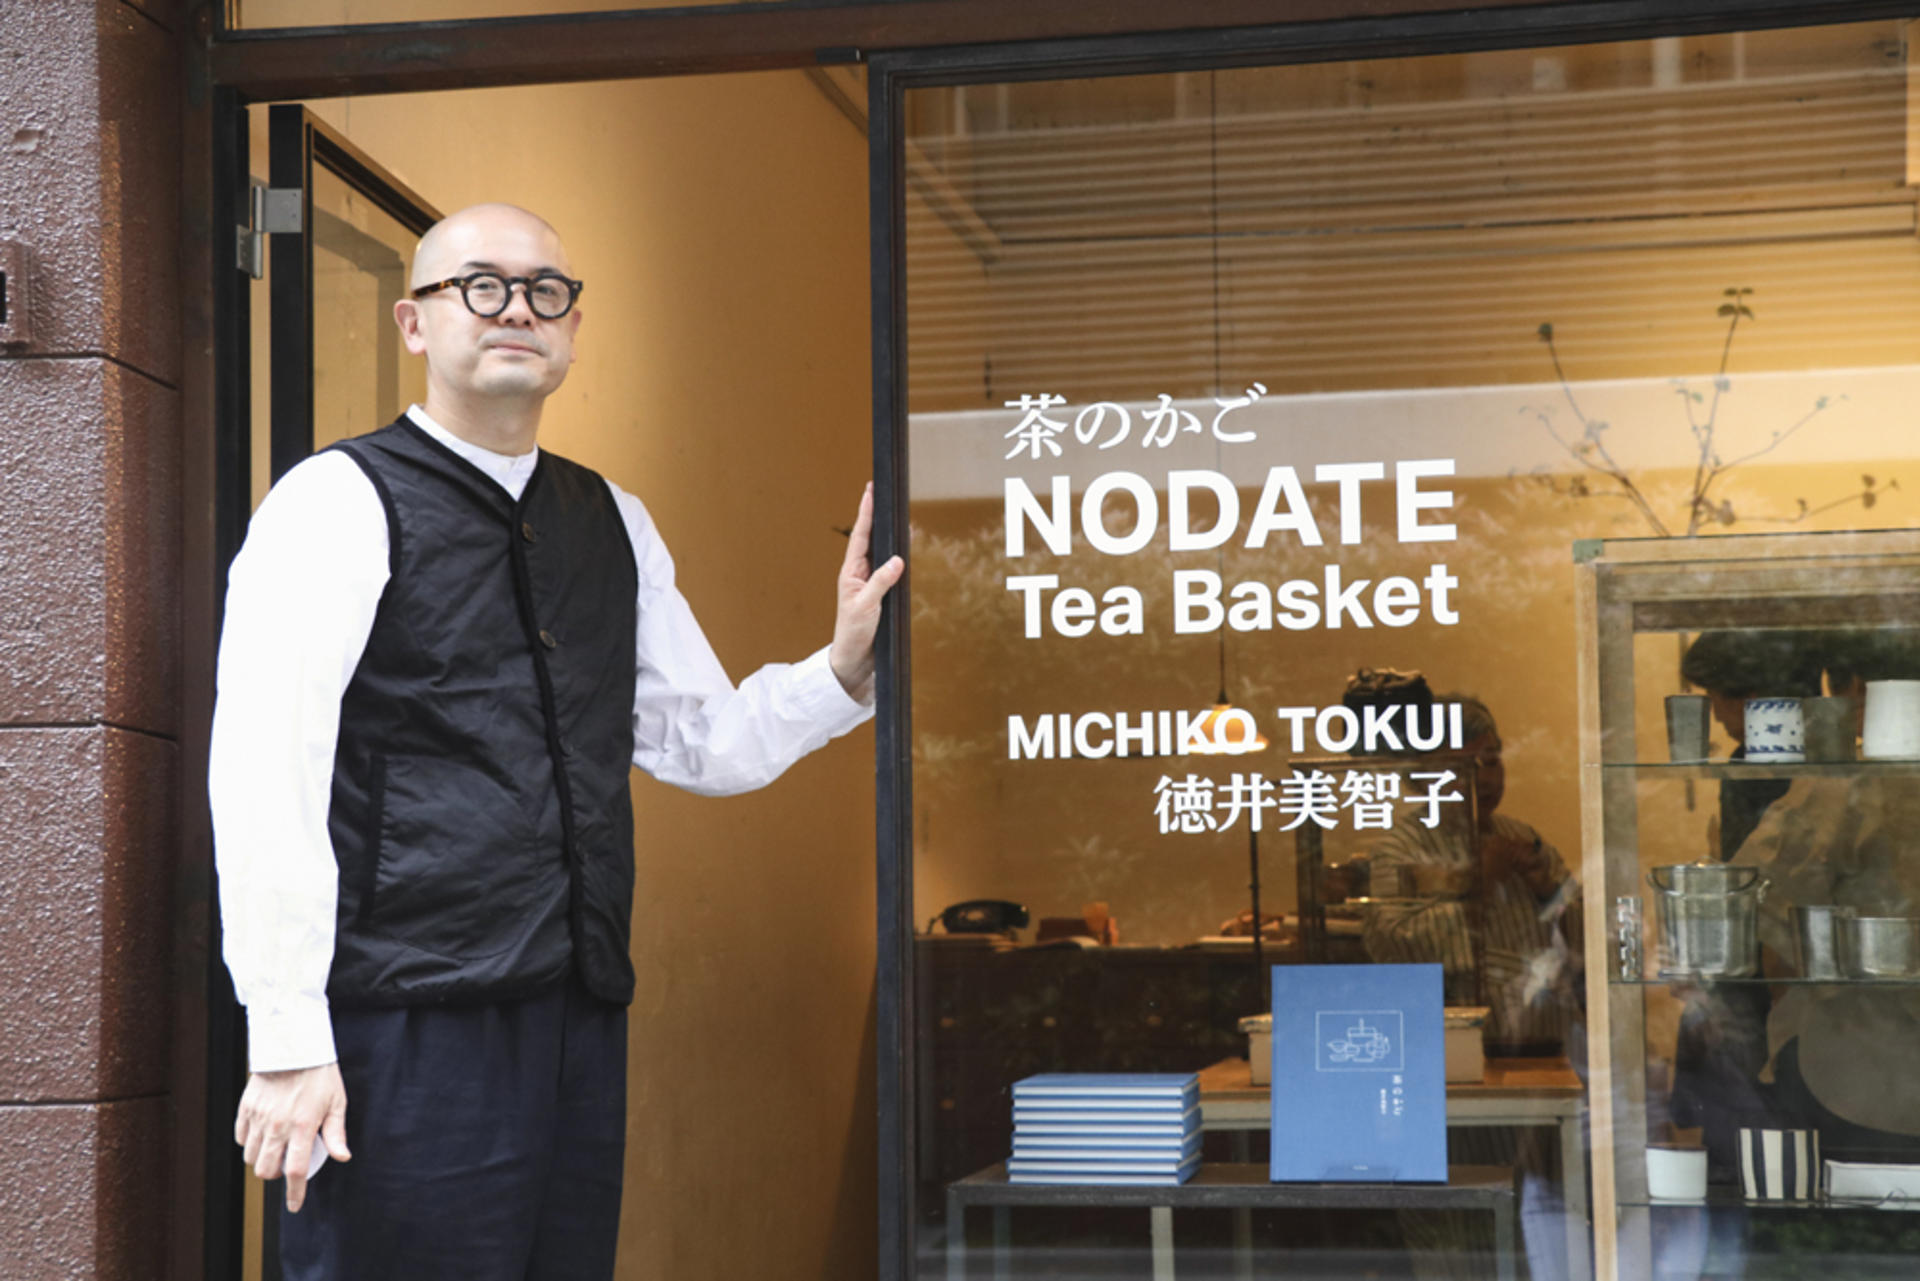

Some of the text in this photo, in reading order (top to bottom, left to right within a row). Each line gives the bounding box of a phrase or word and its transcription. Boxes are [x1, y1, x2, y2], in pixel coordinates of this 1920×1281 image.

[1004, 382, 1267, 459] 茶のかご
[1004, 458, 1458, 558] NODATE
[1005, 564, 1460, 639] Tea Basket
[1007, 702, 1464, 760] MICHIKO TOKUI
[1152, 769, 1465, 835] 徳井美智子
